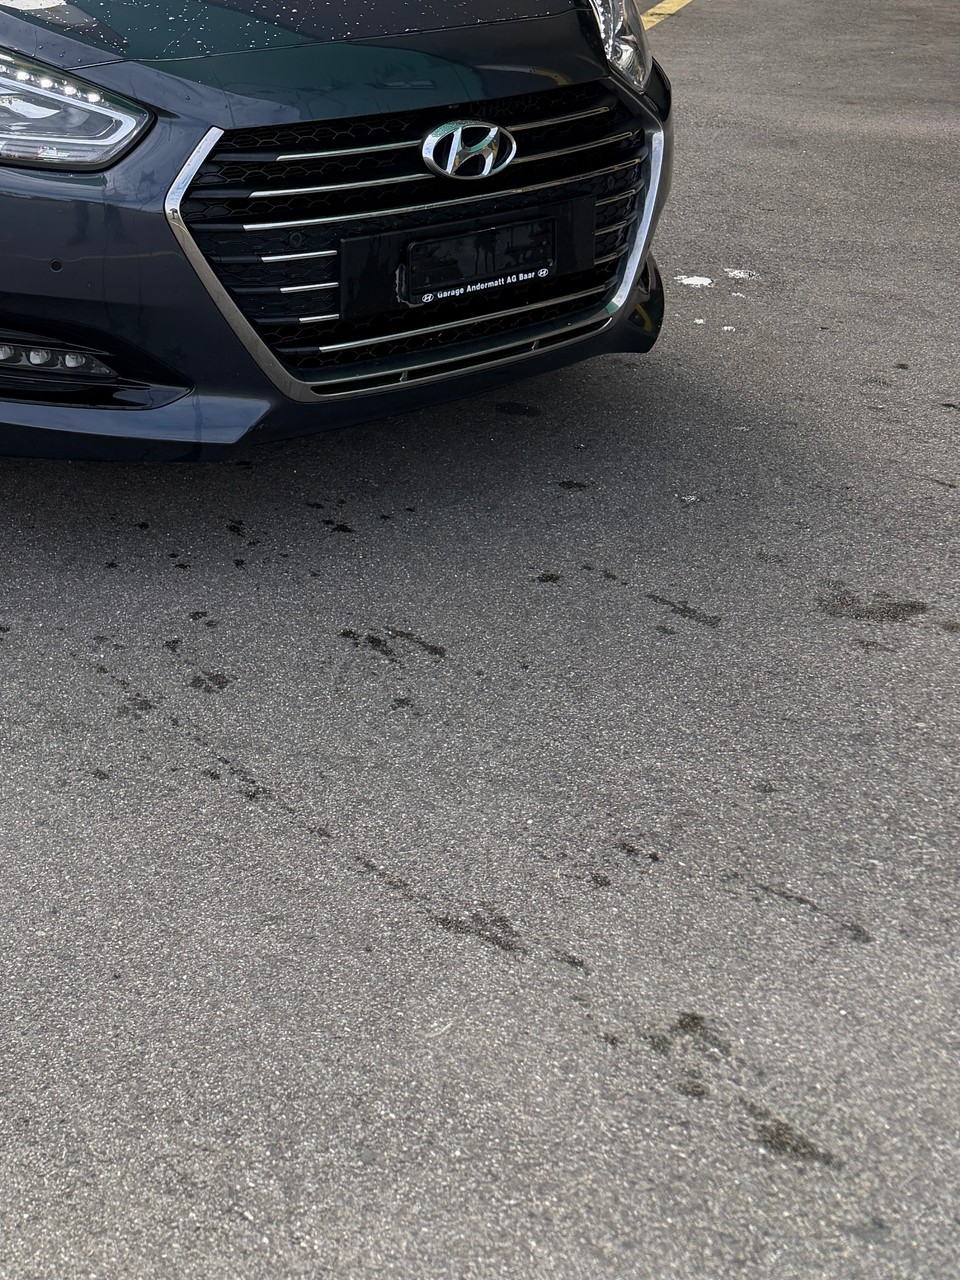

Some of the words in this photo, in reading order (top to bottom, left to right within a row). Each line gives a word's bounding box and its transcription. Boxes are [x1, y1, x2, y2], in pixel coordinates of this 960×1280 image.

[437, 287, 465, 299] Garage
[466, 278, 505, 293] Andermatt
[506, 274, 517, 284] AG
[519, 271, 535, 281] Baar
